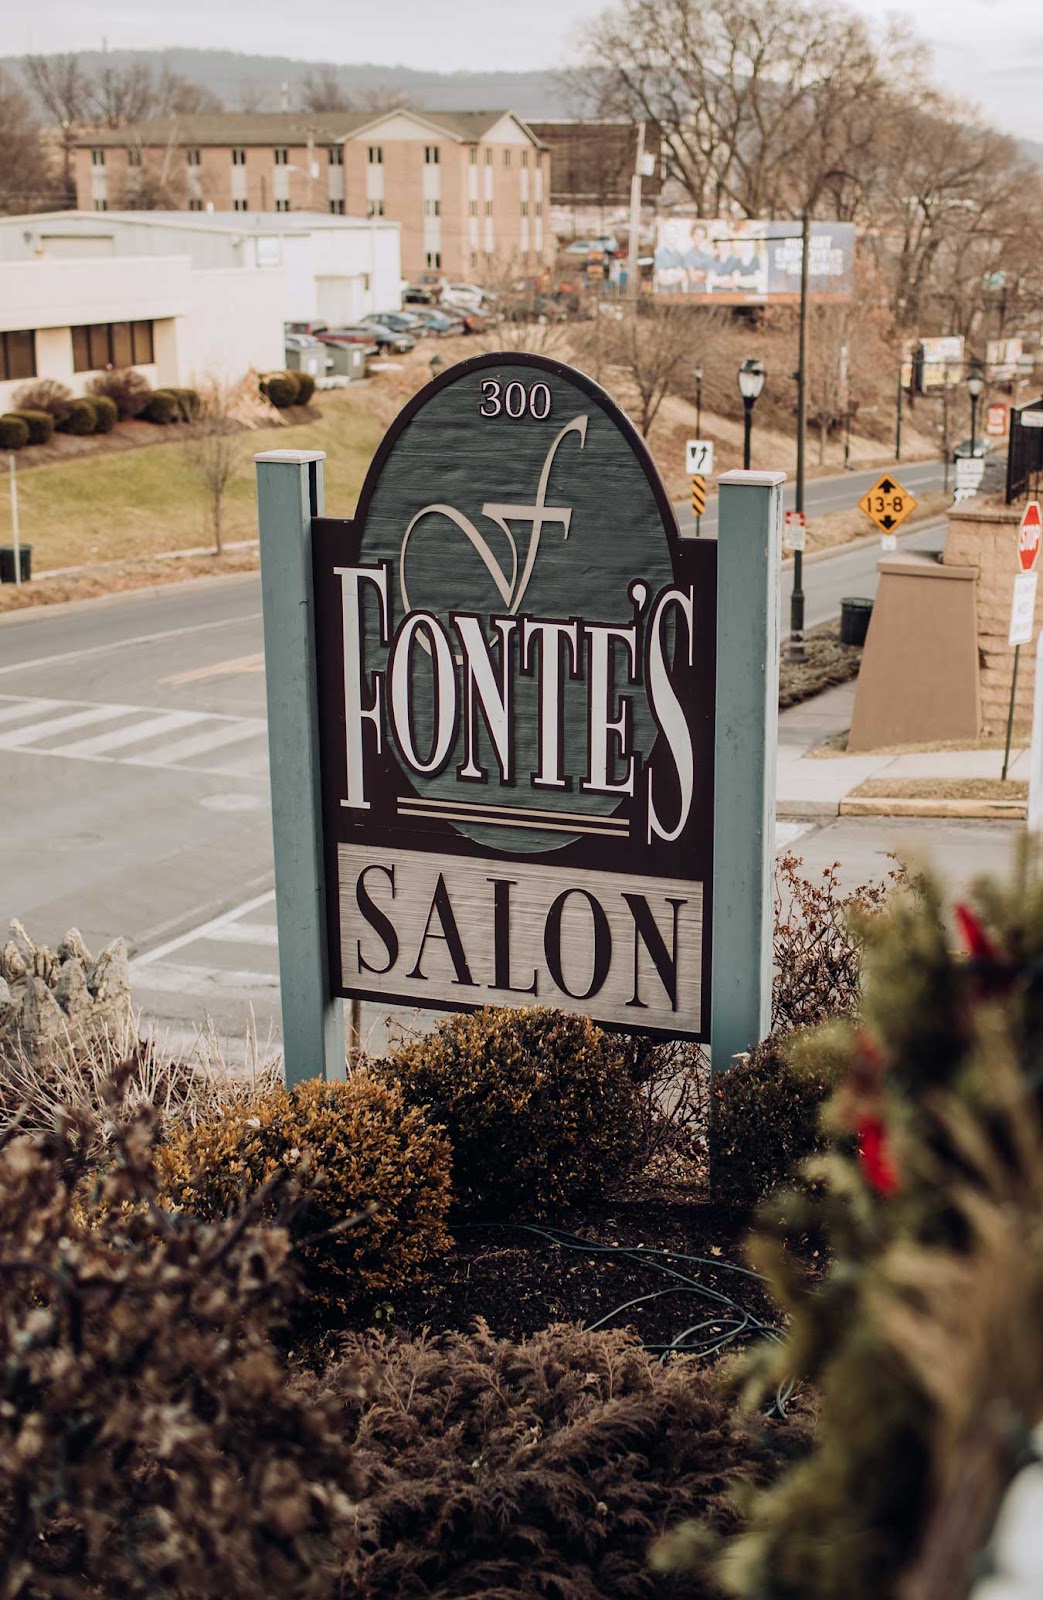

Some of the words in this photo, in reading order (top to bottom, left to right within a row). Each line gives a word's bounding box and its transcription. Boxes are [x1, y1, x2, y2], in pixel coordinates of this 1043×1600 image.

[480, 381, 551, 419] 300
[332, 565, 695, 845] FONTE'S
[356, 864, 688, 1012] SALON
